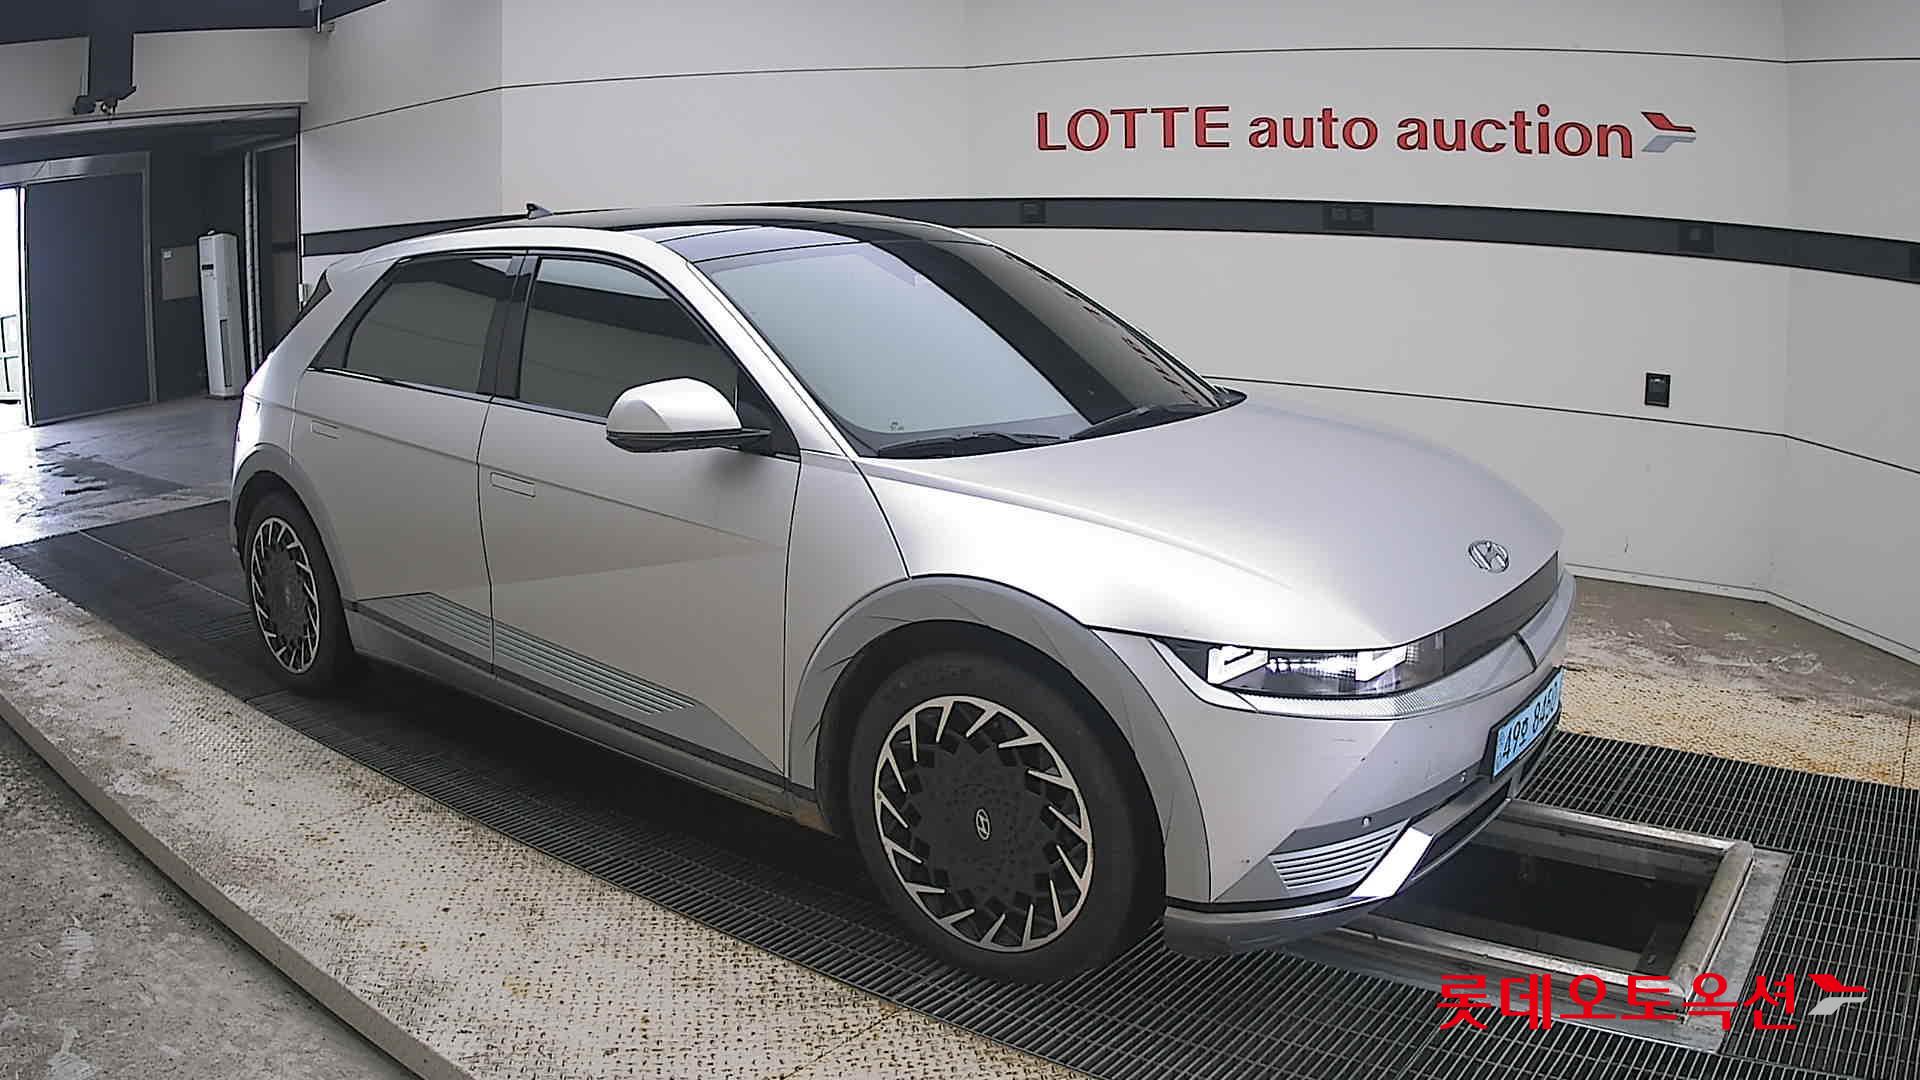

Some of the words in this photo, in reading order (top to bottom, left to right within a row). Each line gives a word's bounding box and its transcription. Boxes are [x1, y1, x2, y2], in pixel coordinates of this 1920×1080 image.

[1037, 105, 1230, 151] LOTTE
[1248, 109, 1379, 150] auto
[1397, 104, 1633, 159] auction
